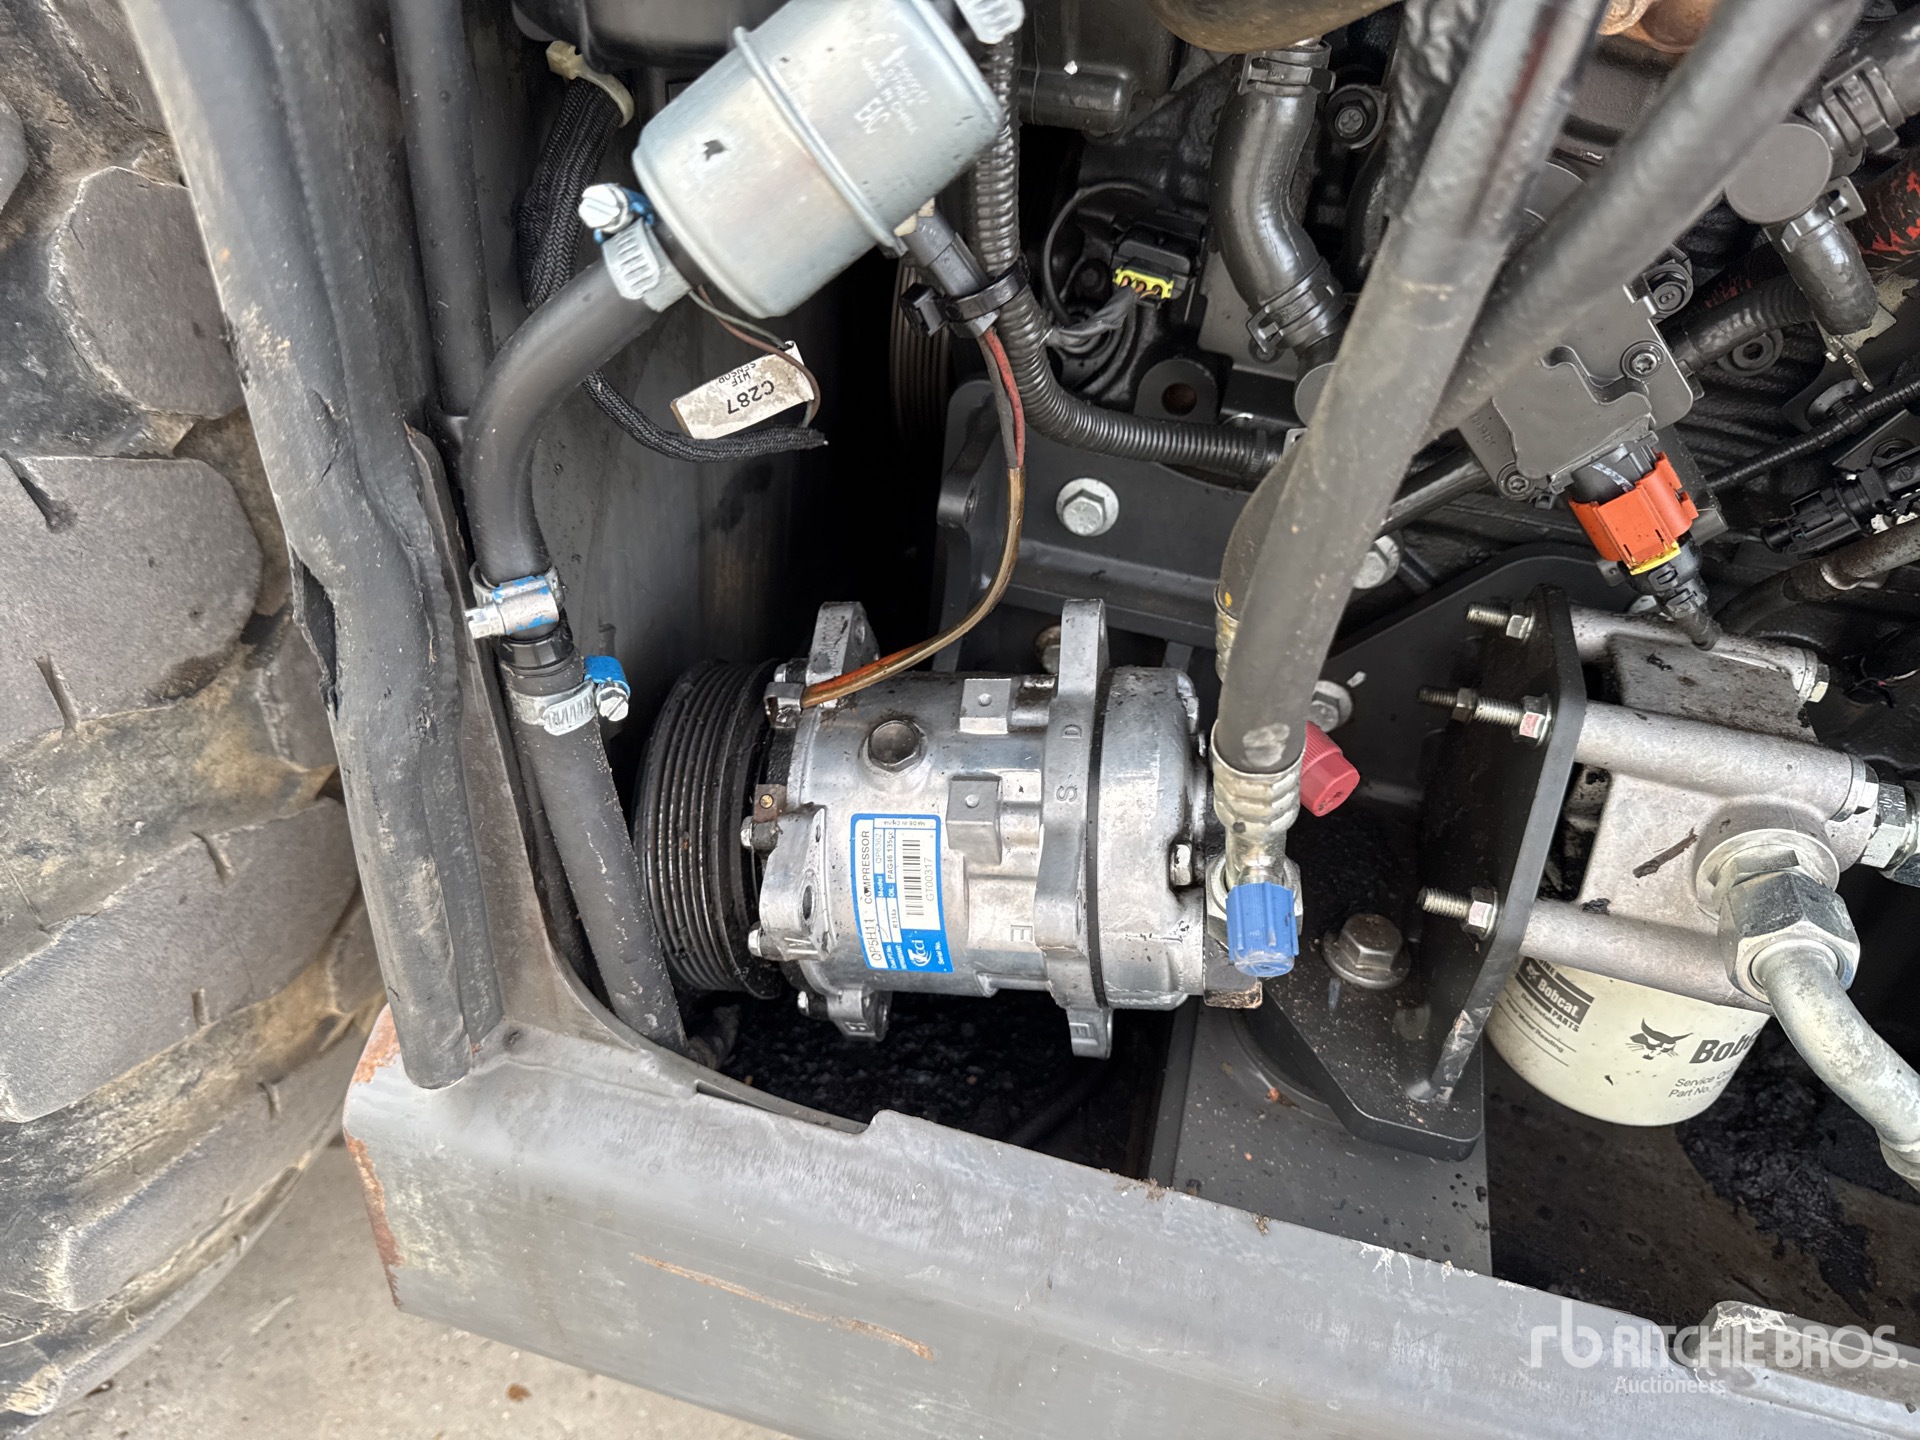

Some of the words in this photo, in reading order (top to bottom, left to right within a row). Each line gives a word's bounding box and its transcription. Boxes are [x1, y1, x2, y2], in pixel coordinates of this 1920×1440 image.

[731, 371, 751, 388] WIF
[727, 380, 775, 415] C287
[861, 830, 873, 905] COMPRESSOR
[924, 857, 935, 902] GT00317
[864, 918, 883, 962] QP5H11
[1537, 978, 1579, 1018] Bobcat
[1550, 1009, 1580, 1033] PARTS
[1667, 1089, 1694, 1098] Part
[1674, 1076, 1716, 1088] Service
